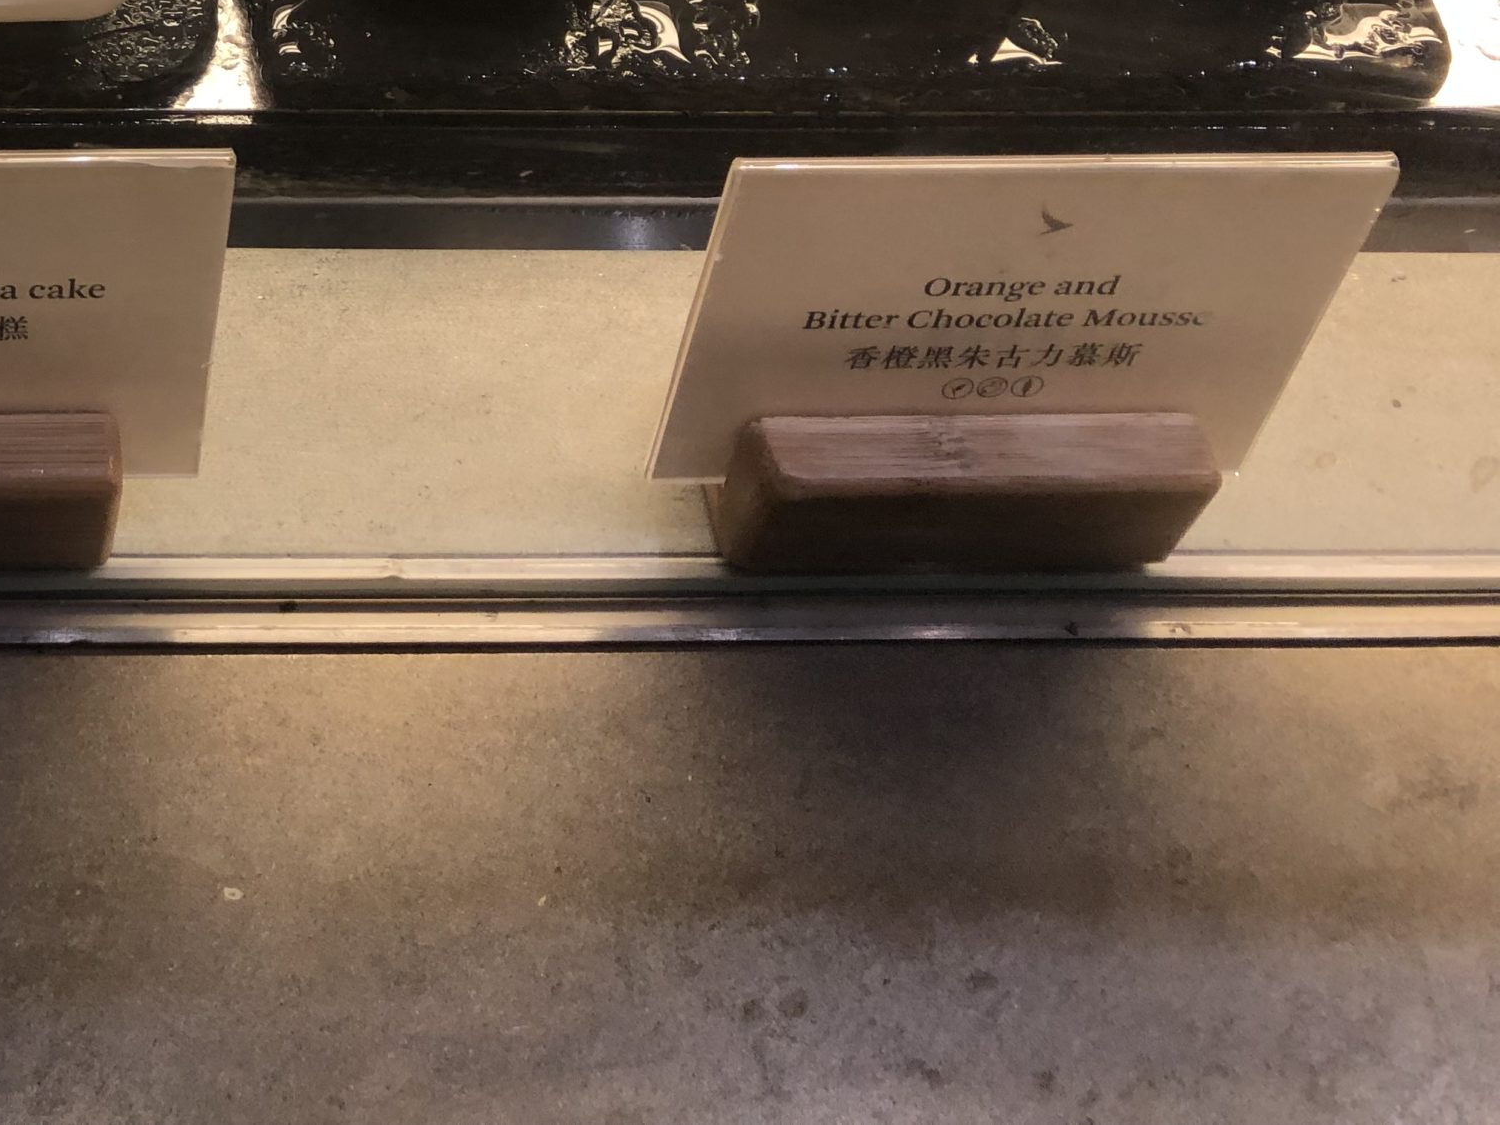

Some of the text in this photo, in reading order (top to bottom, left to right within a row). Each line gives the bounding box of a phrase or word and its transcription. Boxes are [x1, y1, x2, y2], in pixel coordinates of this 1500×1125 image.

[28, 278, 106, 300] cake
[924, 275, 1121, 303] Orange and
[802, 309, 898, 330] Bitter
[906, 307, 1074, 330] Chocolate
[844, 342, 1143, 371] 香橙黑朱古力慕斯
